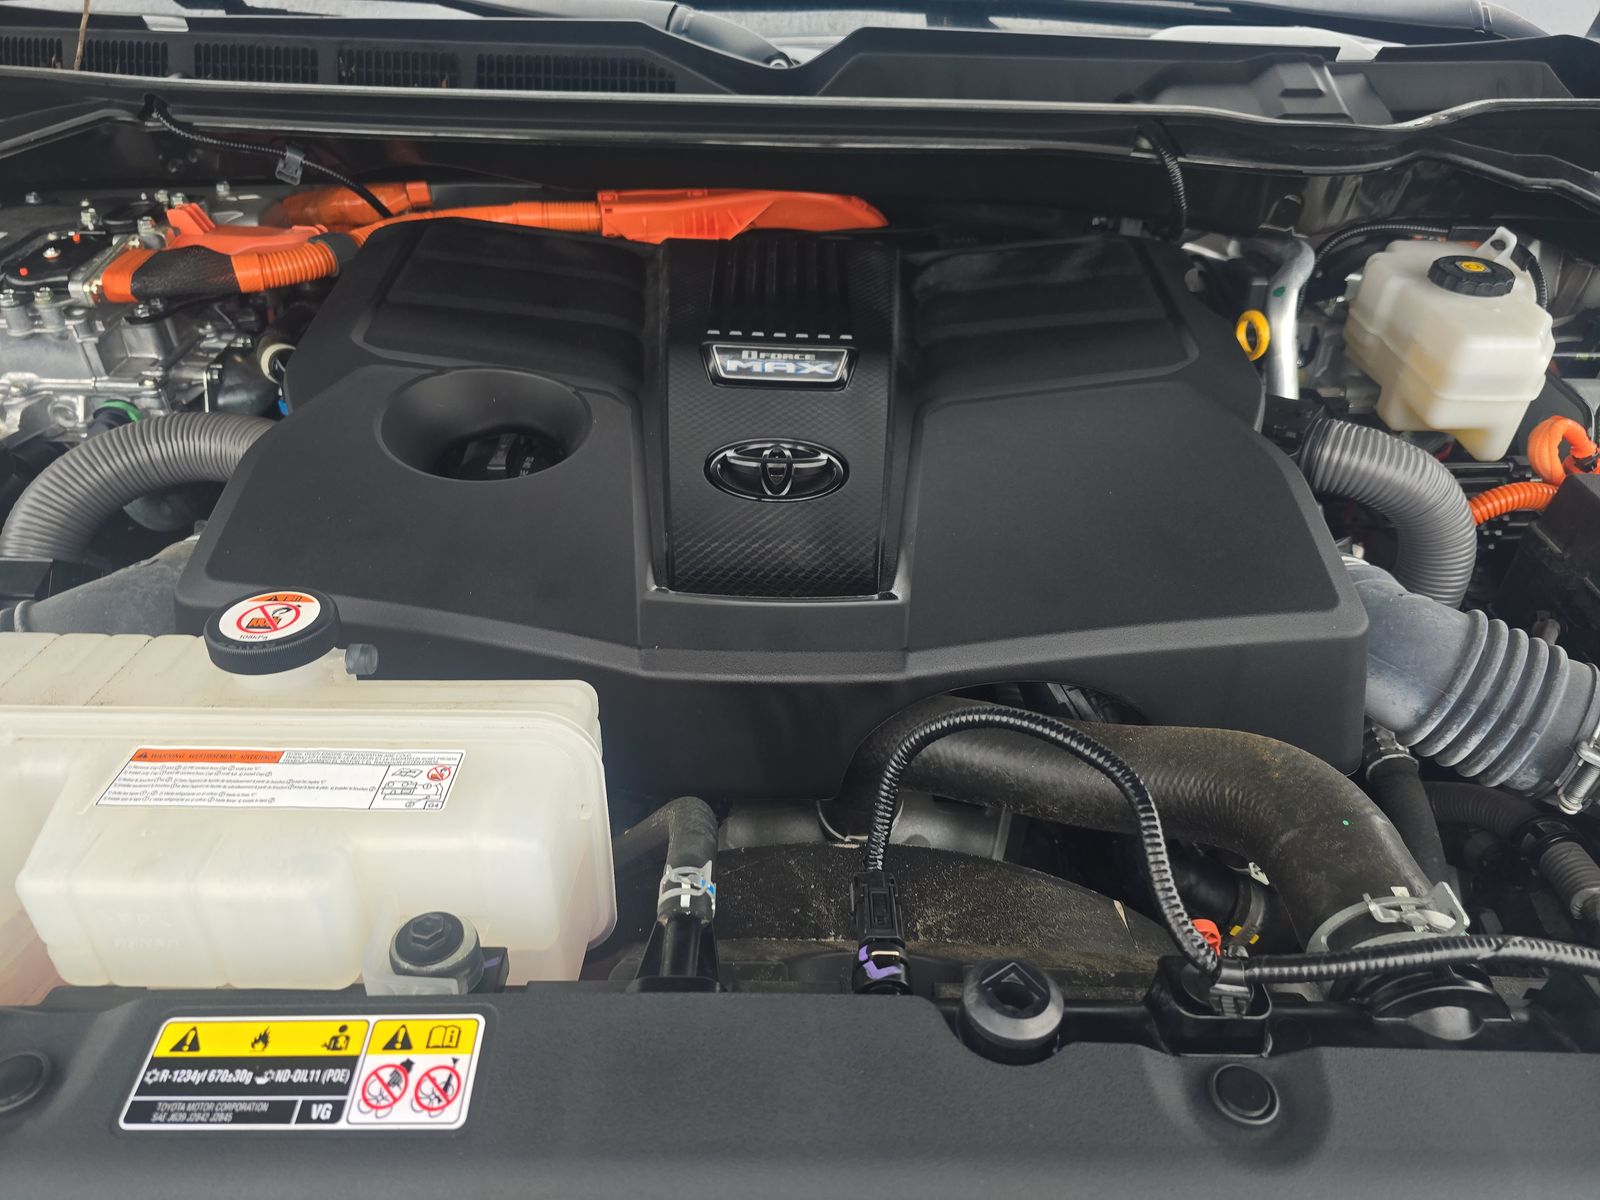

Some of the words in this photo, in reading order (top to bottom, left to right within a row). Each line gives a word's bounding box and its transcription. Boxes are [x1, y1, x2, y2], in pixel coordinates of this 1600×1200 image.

[726, 359, 833, 375] MAX
[321, 1068, 351, 1086] (POE)
[157, 1102, 187, 1112] TOYOTA
[187, 1102, 216, 1112] MOTOR
[215, 1102, 270, 1113] CORPORATION
[310, 1103, 333, 1120] VG
